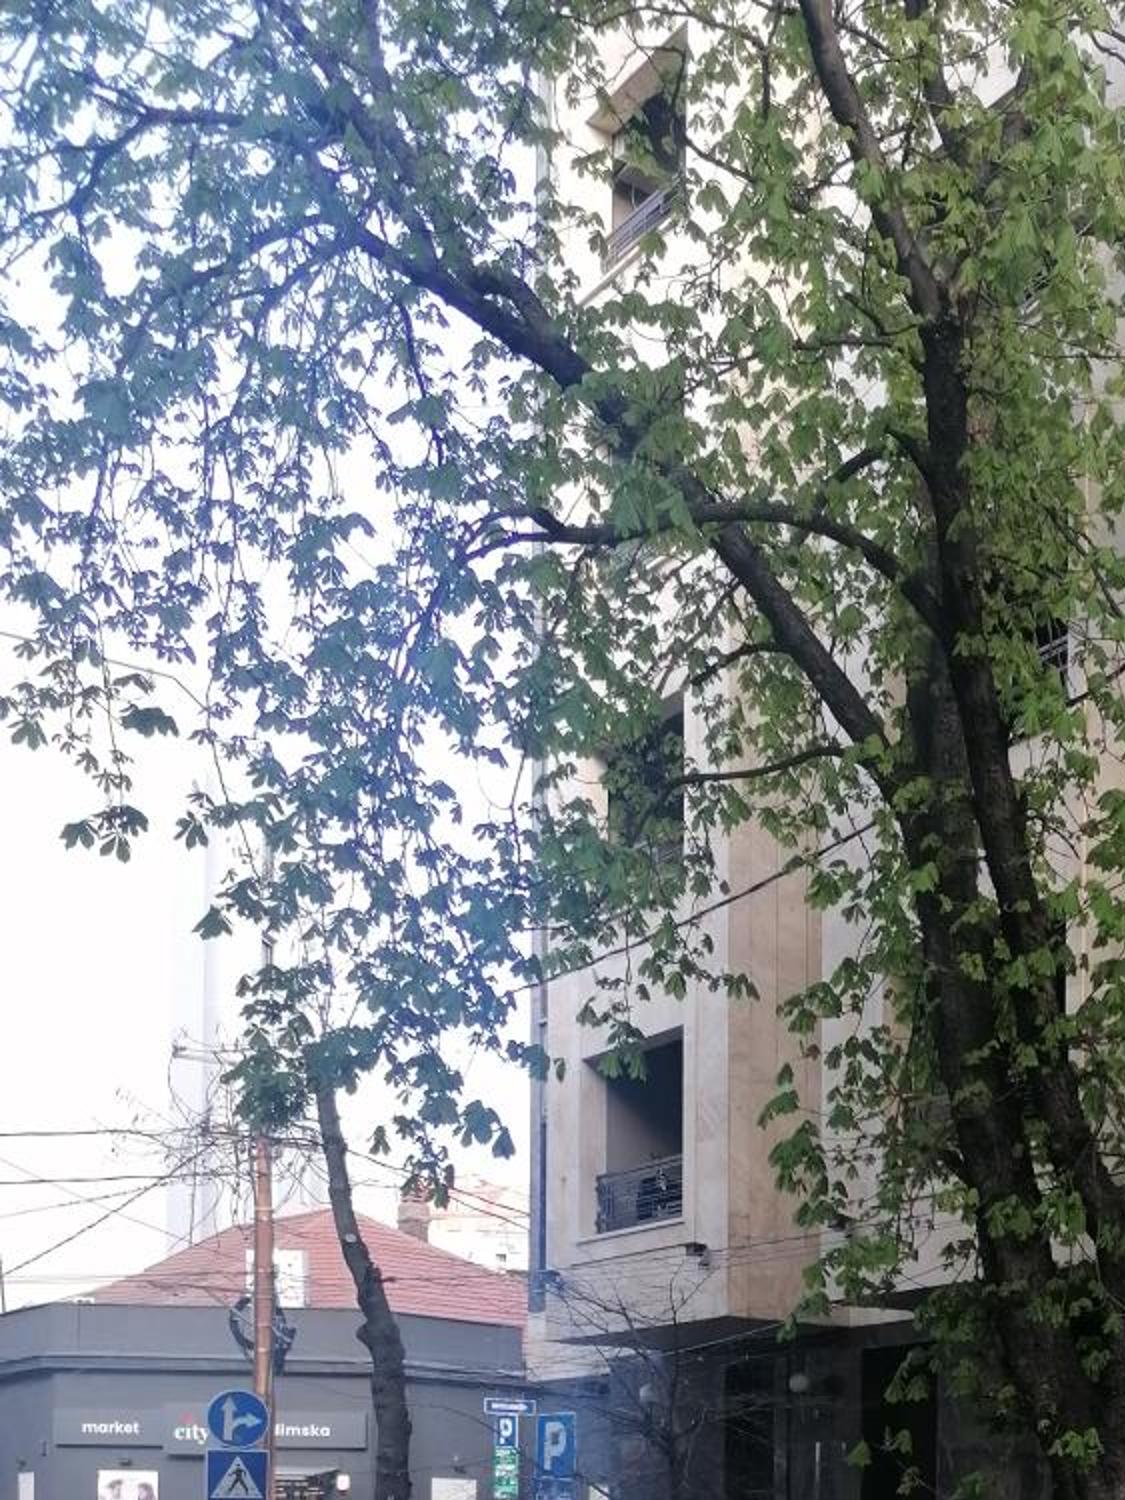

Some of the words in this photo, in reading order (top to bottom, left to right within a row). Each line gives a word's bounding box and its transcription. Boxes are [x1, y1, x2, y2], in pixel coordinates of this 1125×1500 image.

[81, 1422, 140, 1435] market
[174, 1422, 209, 1445] city
[275, 1423, 331, 1437] limska
[543, 1421, 567, 1471] P
